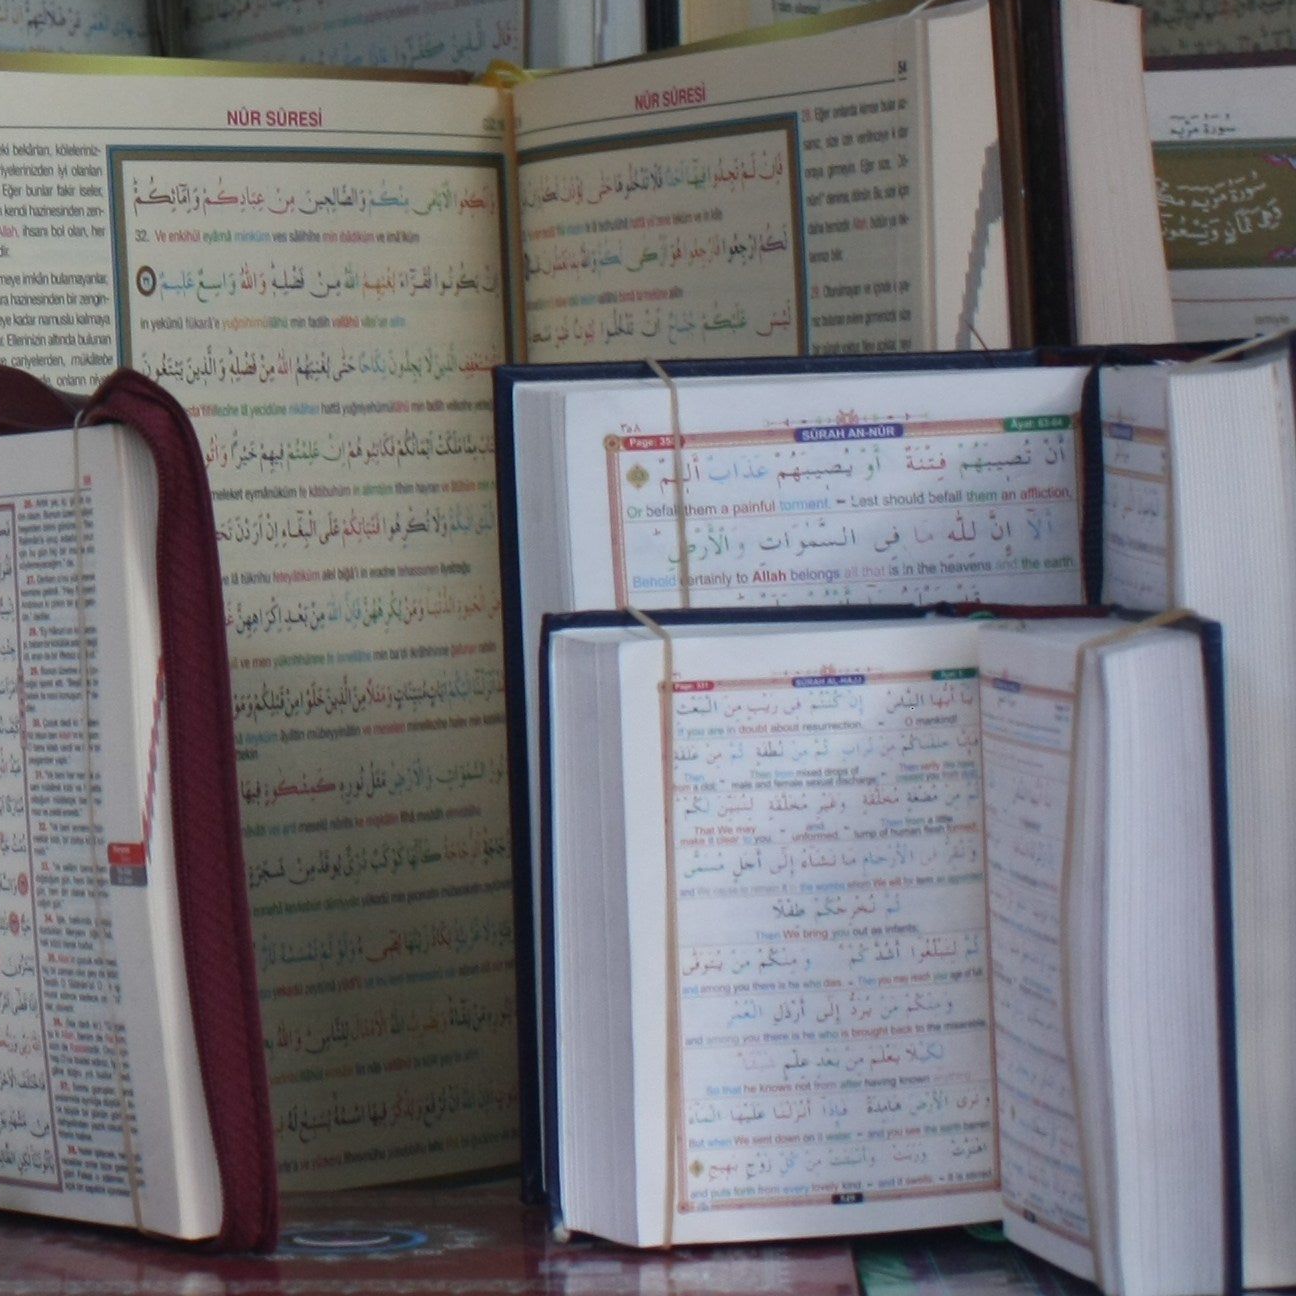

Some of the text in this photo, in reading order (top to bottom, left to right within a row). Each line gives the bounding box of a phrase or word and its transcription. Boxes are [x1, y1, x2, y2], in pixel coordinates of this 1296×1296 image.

[626, 506, 643, 519] Or
[733, 500, 775, 516] painful
[883, 491, 925, 510] should
[928, 490, 963, 508] befall
[967, 491, 998, 506] them
[1001, 491, 1016, 505] an
[736, 572, 748, 584] to
[753, 570, 786, 582] Allah
[791, 569, 841, 584] belongs
[917, 562, 937, 578] the
[940, 561, 993, 577] heavens
[1021, 558, 1041, 570] the
